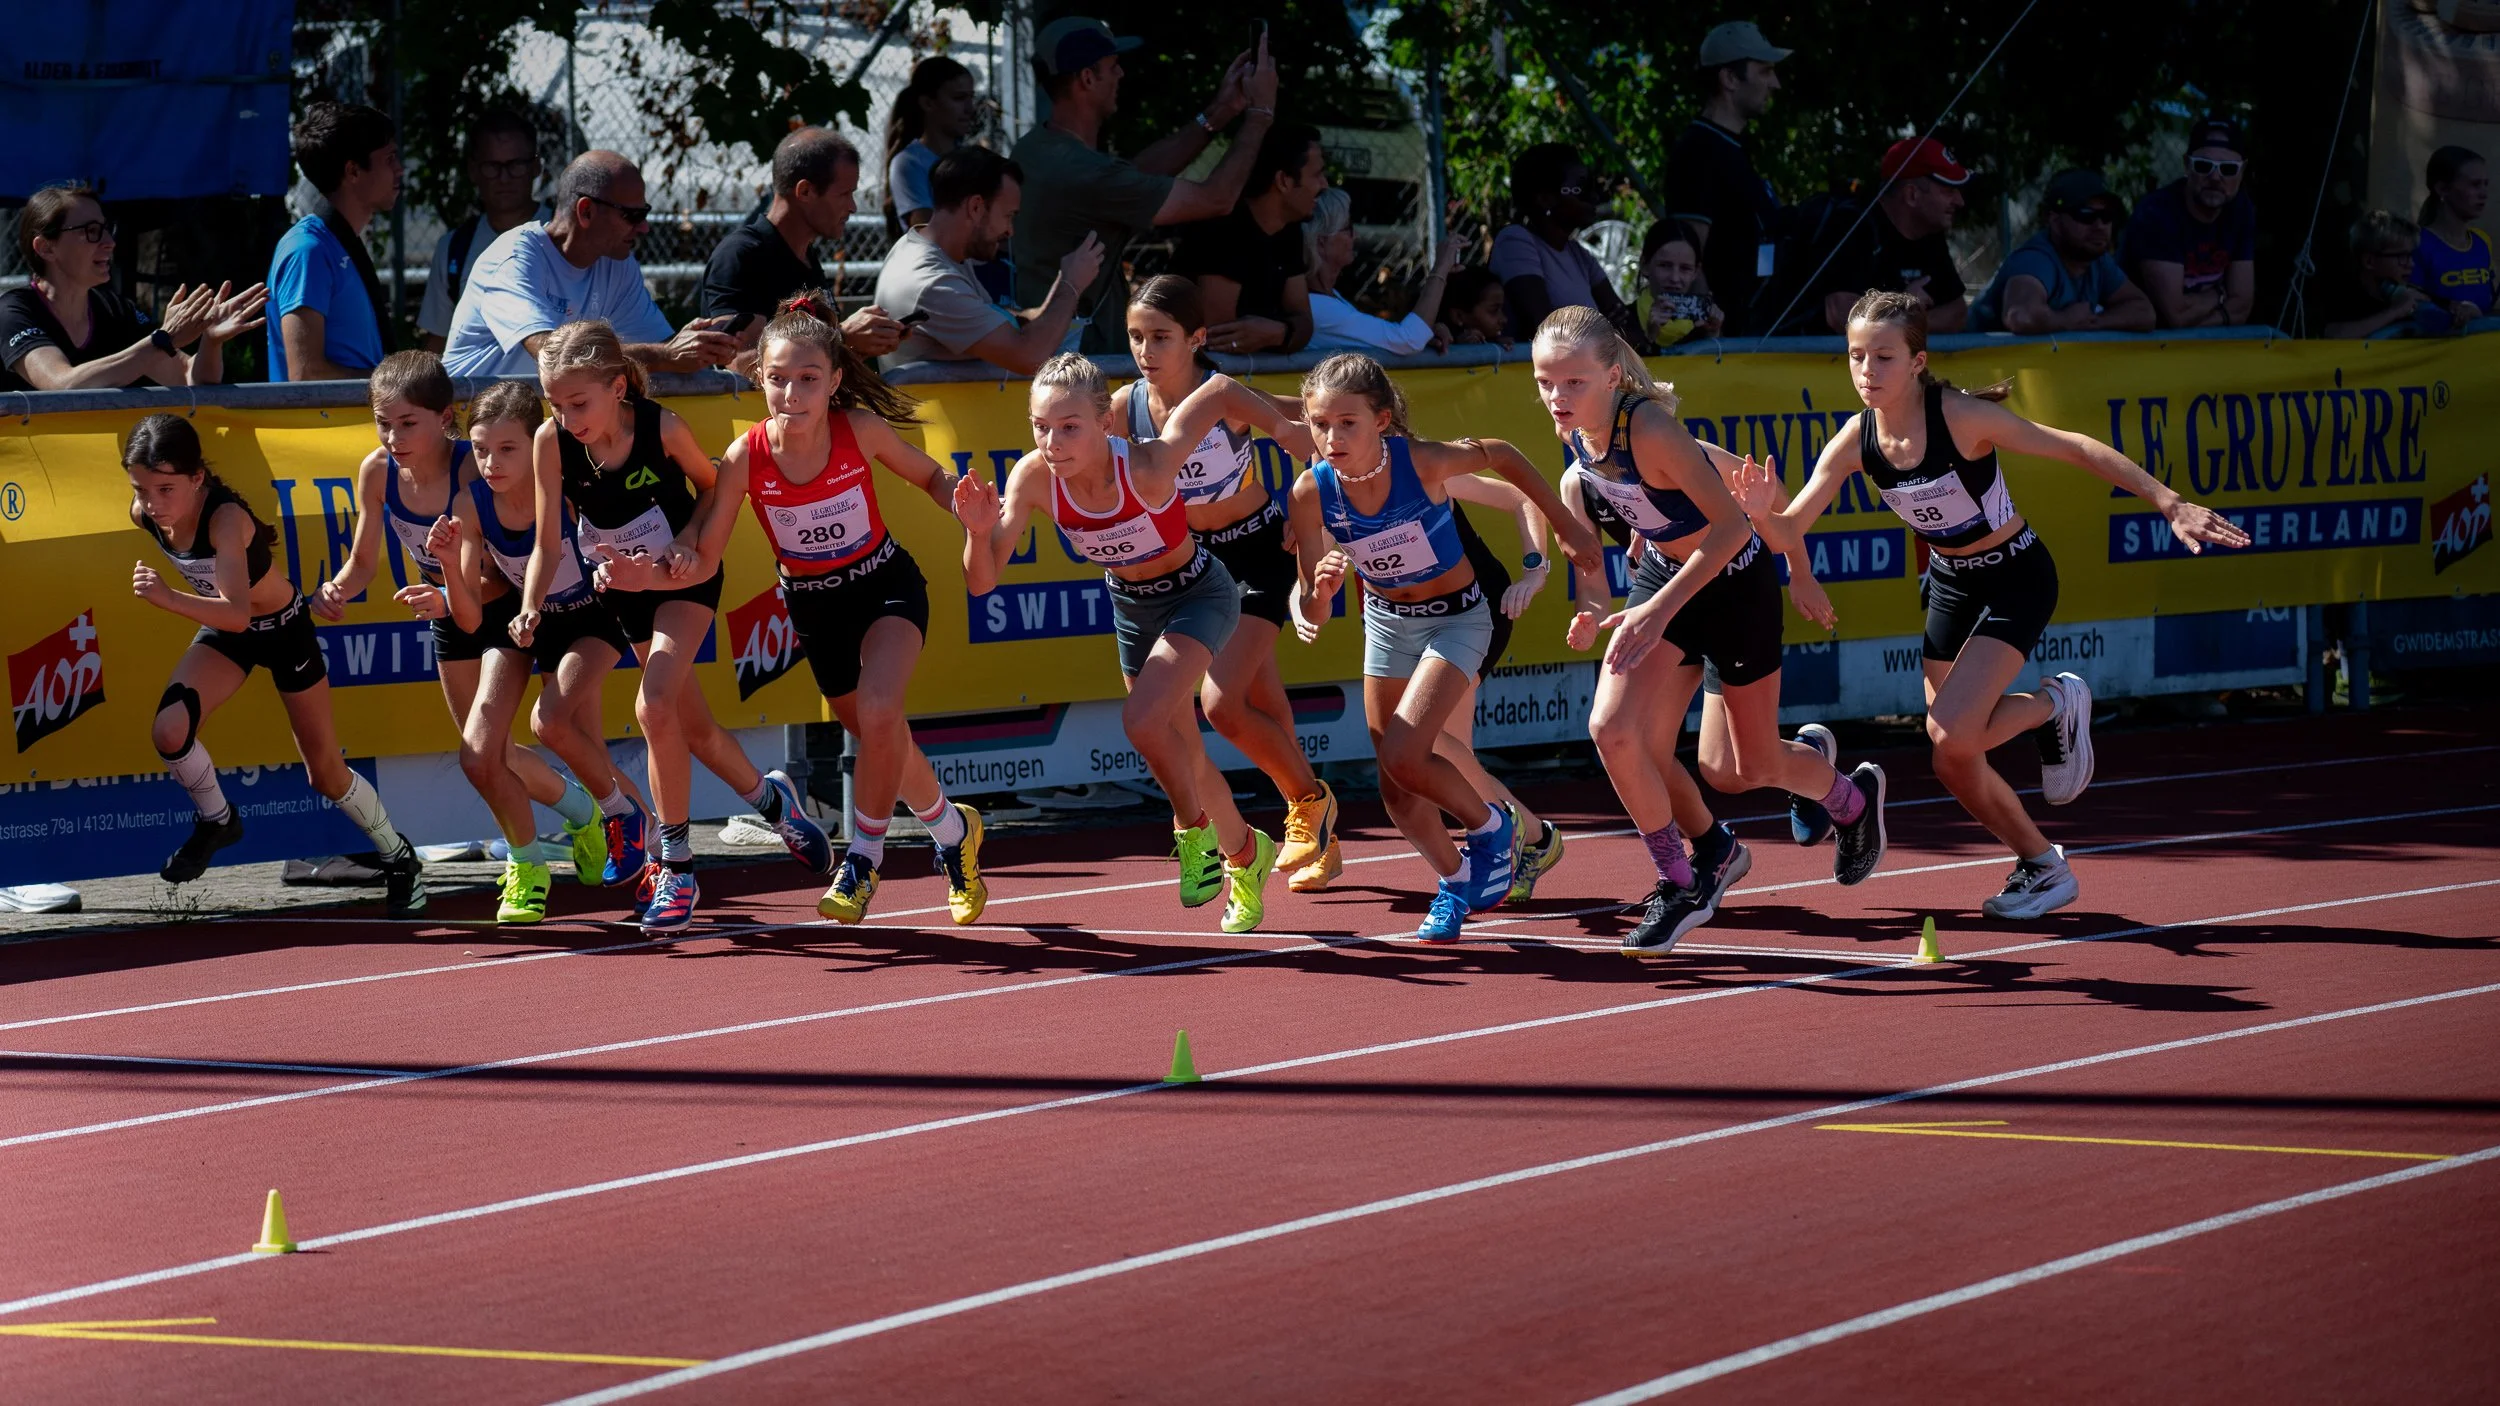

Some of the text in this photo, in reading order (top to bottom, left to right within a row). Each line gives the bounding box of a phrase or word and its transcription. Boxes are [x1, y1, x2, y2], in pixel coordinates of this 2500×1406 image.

[2186, 368, 2427, 496] GRUYÈRE
[1896, 477, 1921, 489] CRAFT
[1912, 506, 1943, 523] 58
[797, 522, 846, 545] 280
[1211, 515, 1263, 545] NIKE
[805, 540, 846, 552] SCHNEITER
[1086, 541, 1135, 557] 206
[849, 537, 896, 582] NIKE
[1361, 553, 1405, 572] 162
[1953, 551, 2004, 571] PRO
[792, 575, 843, 592] PRO
[1124, 579, 1174, 596] PRO
[1395, 600, 1449, 617] PRO
[2393, 628, 2500, 654] GWIDEMSTRAS
[51, 817, 74, 836] 79a
[84, 813, 114, 832] 4132
[117, 811, 166, 829] Muttenz
